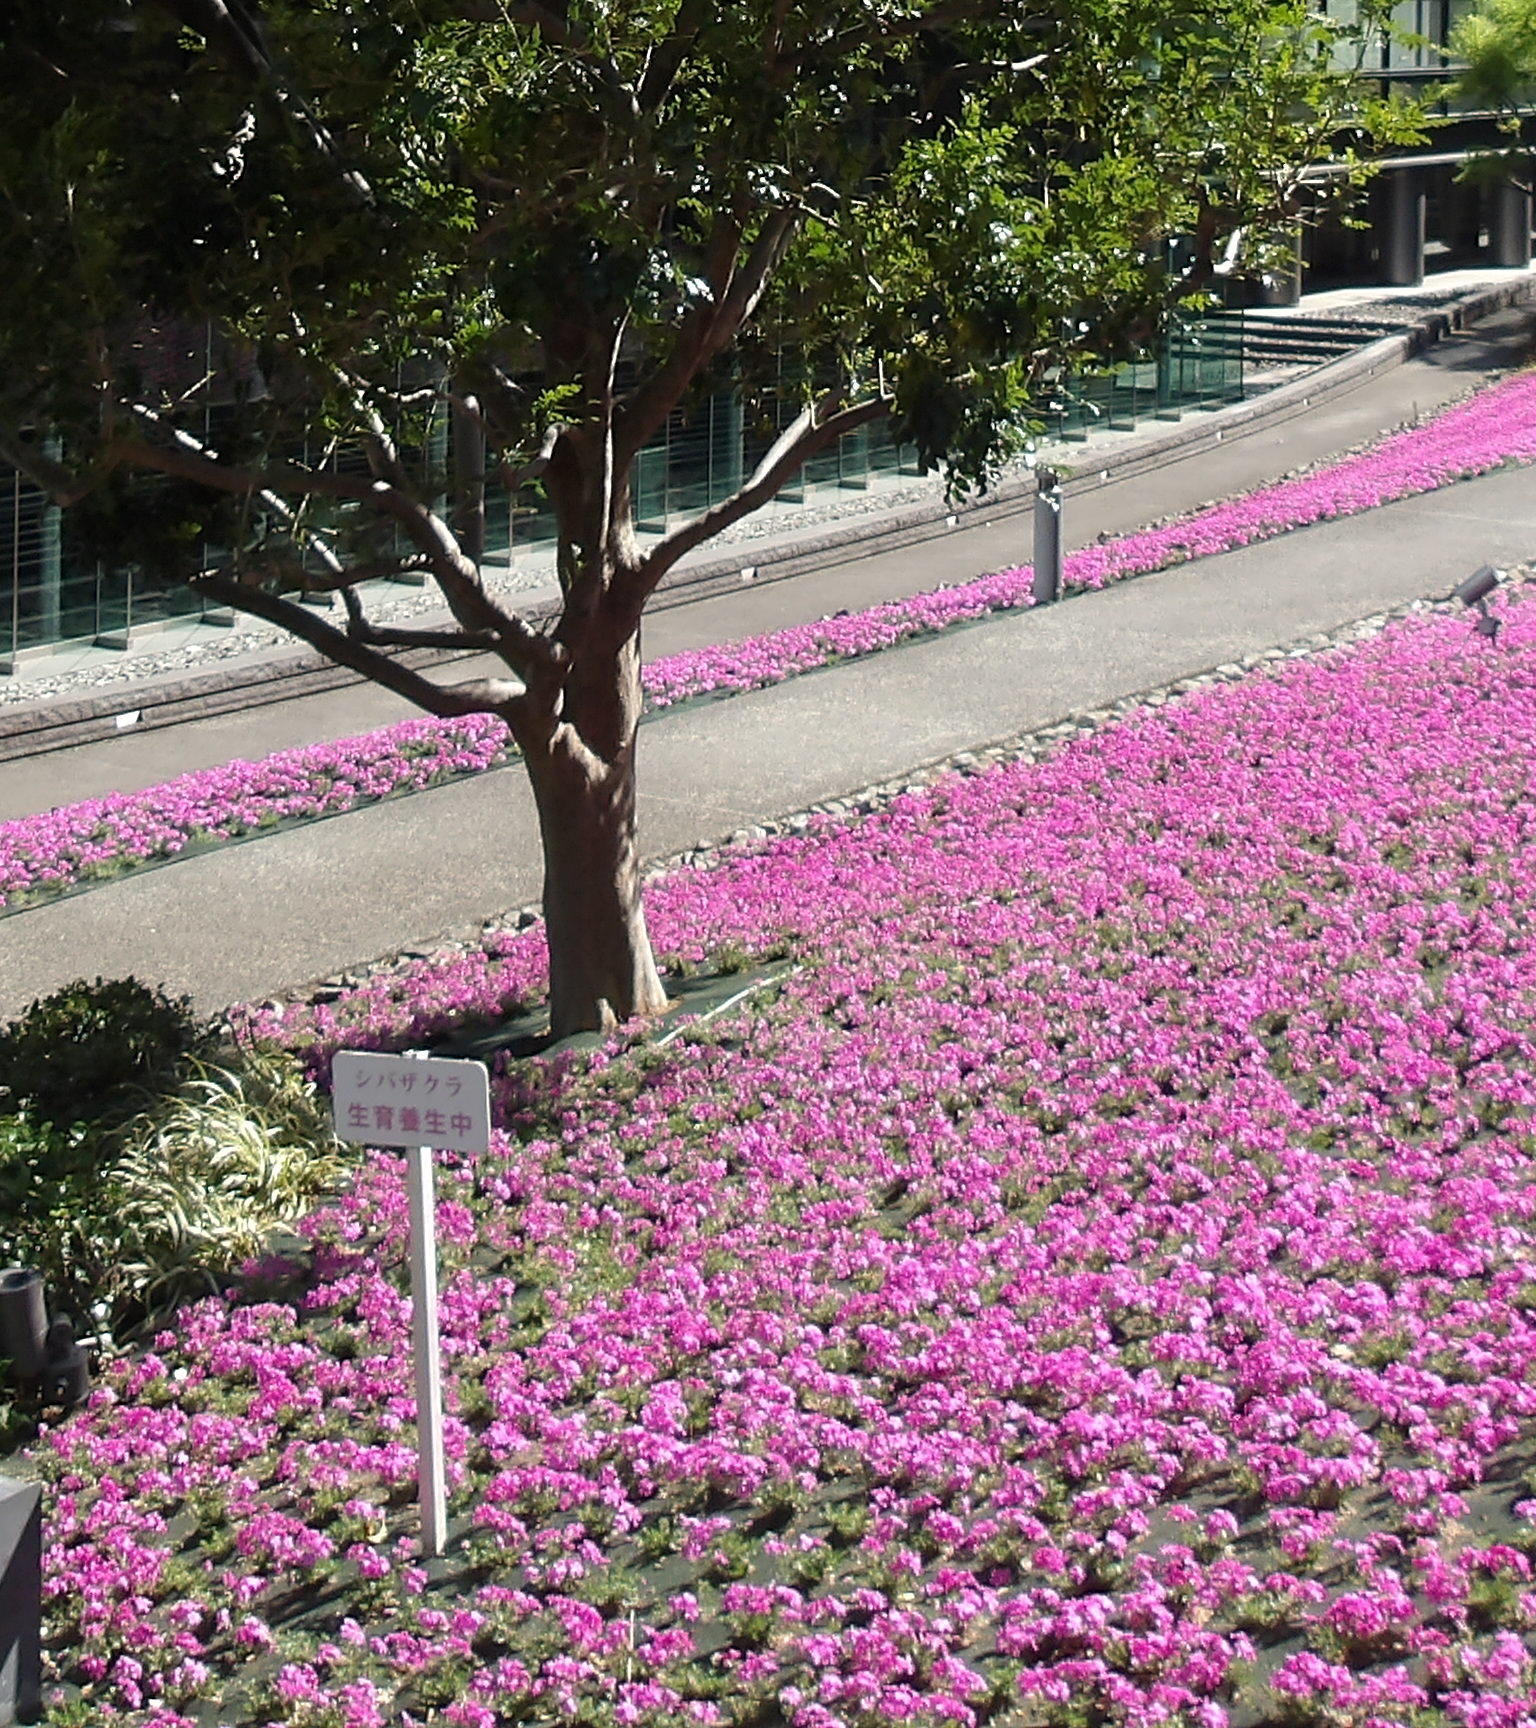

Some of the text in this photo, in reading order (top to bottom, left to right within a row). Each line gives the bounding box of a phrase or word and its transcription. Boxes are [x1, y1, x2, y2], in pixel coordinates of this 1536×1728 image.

[355, 1068, 463, 1097] シバザクラ
